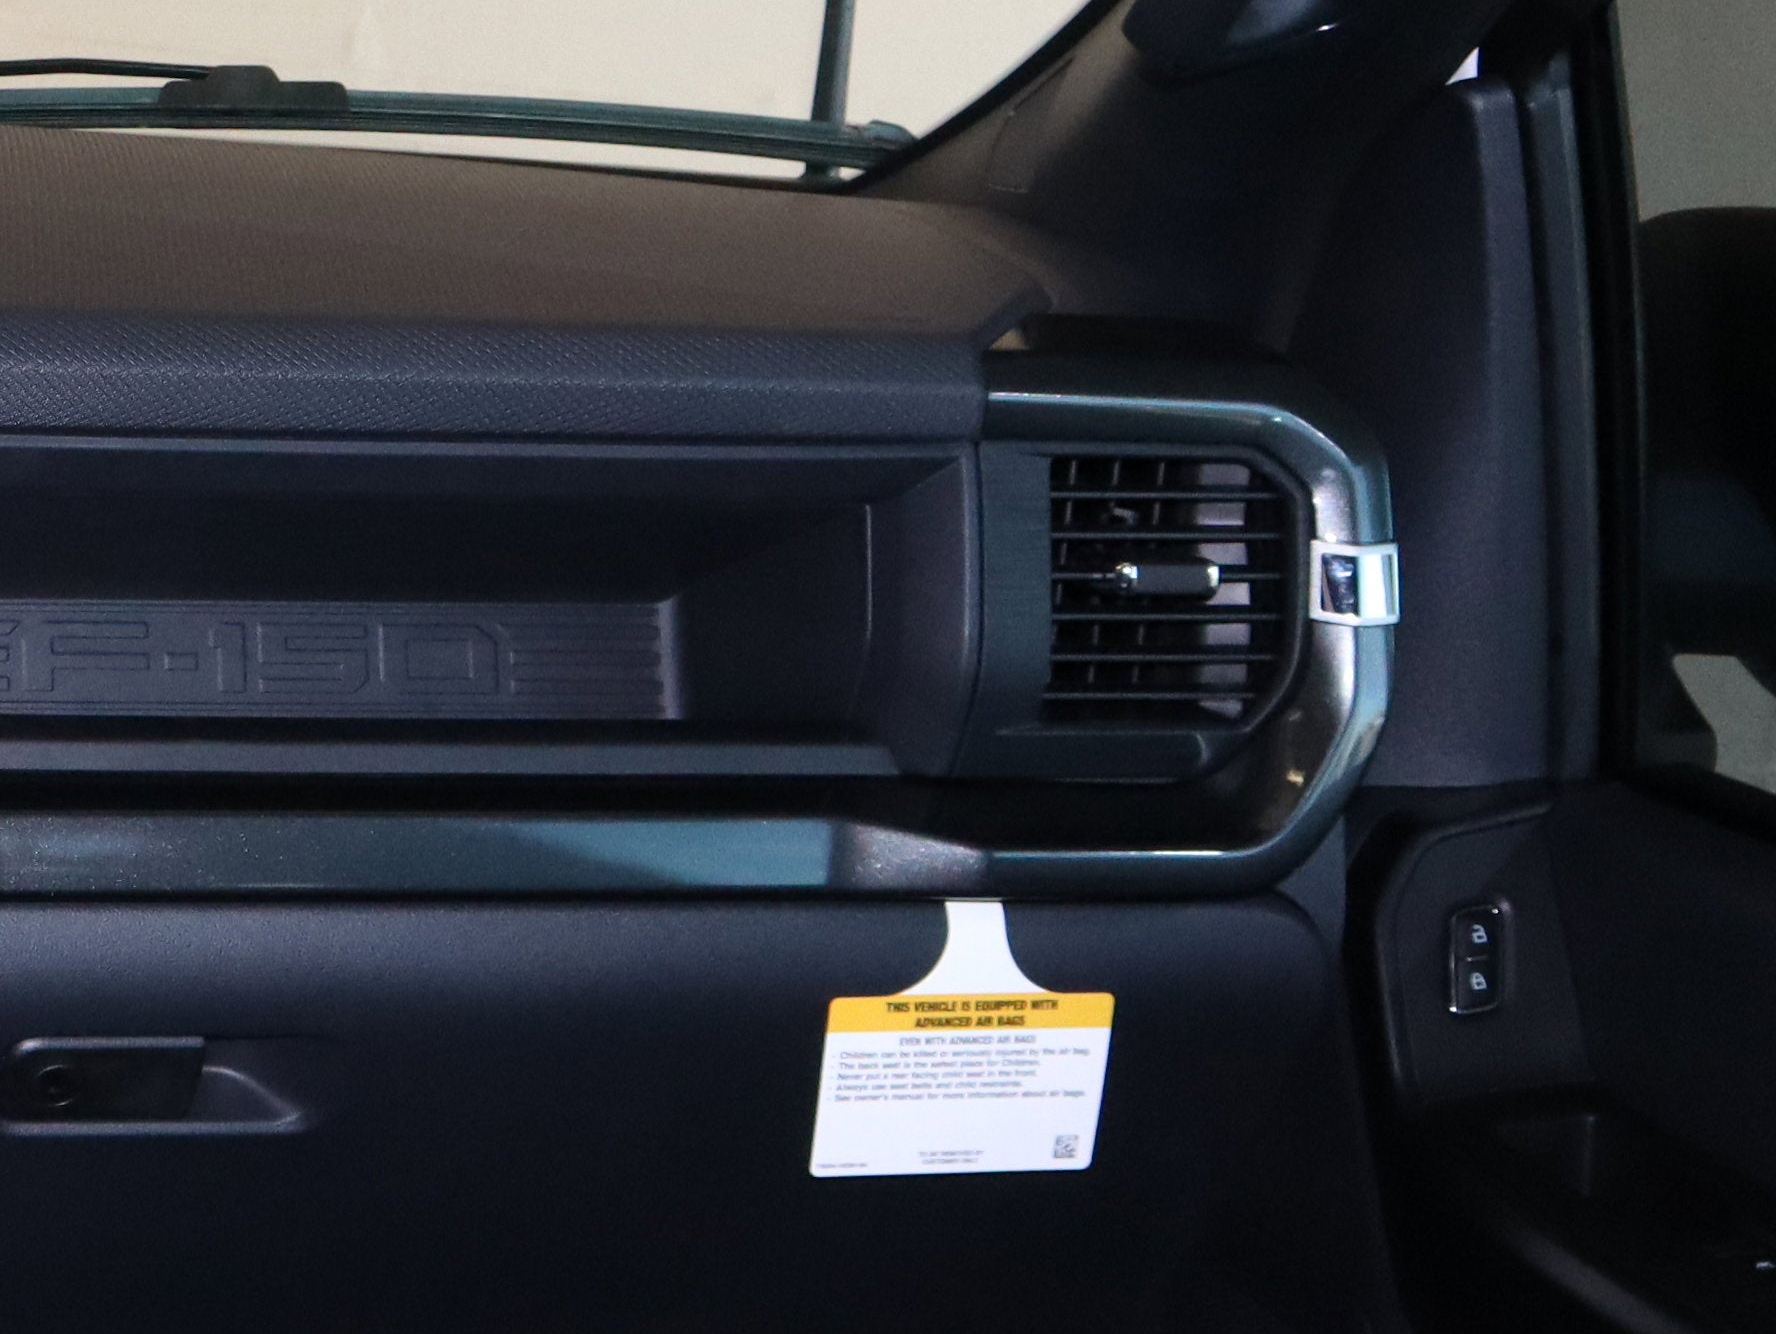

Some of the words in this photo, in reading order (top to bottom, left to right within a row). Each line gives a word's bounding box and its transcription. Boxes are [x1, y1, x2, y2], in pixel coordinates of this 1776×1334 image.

[22, 619, 501, 696] F-150
[887, 1002, 910, 1012] THIS
[914, 1001, 957, 1012] VEHICLE
[975, 1000, 1027, 1010] EQUIPPED
[1031, 999, 1058, 1009] WITH
[916, 1017, 972, 1027] ADVANCED
[997, 1016, 1025, 1025] BAGS
